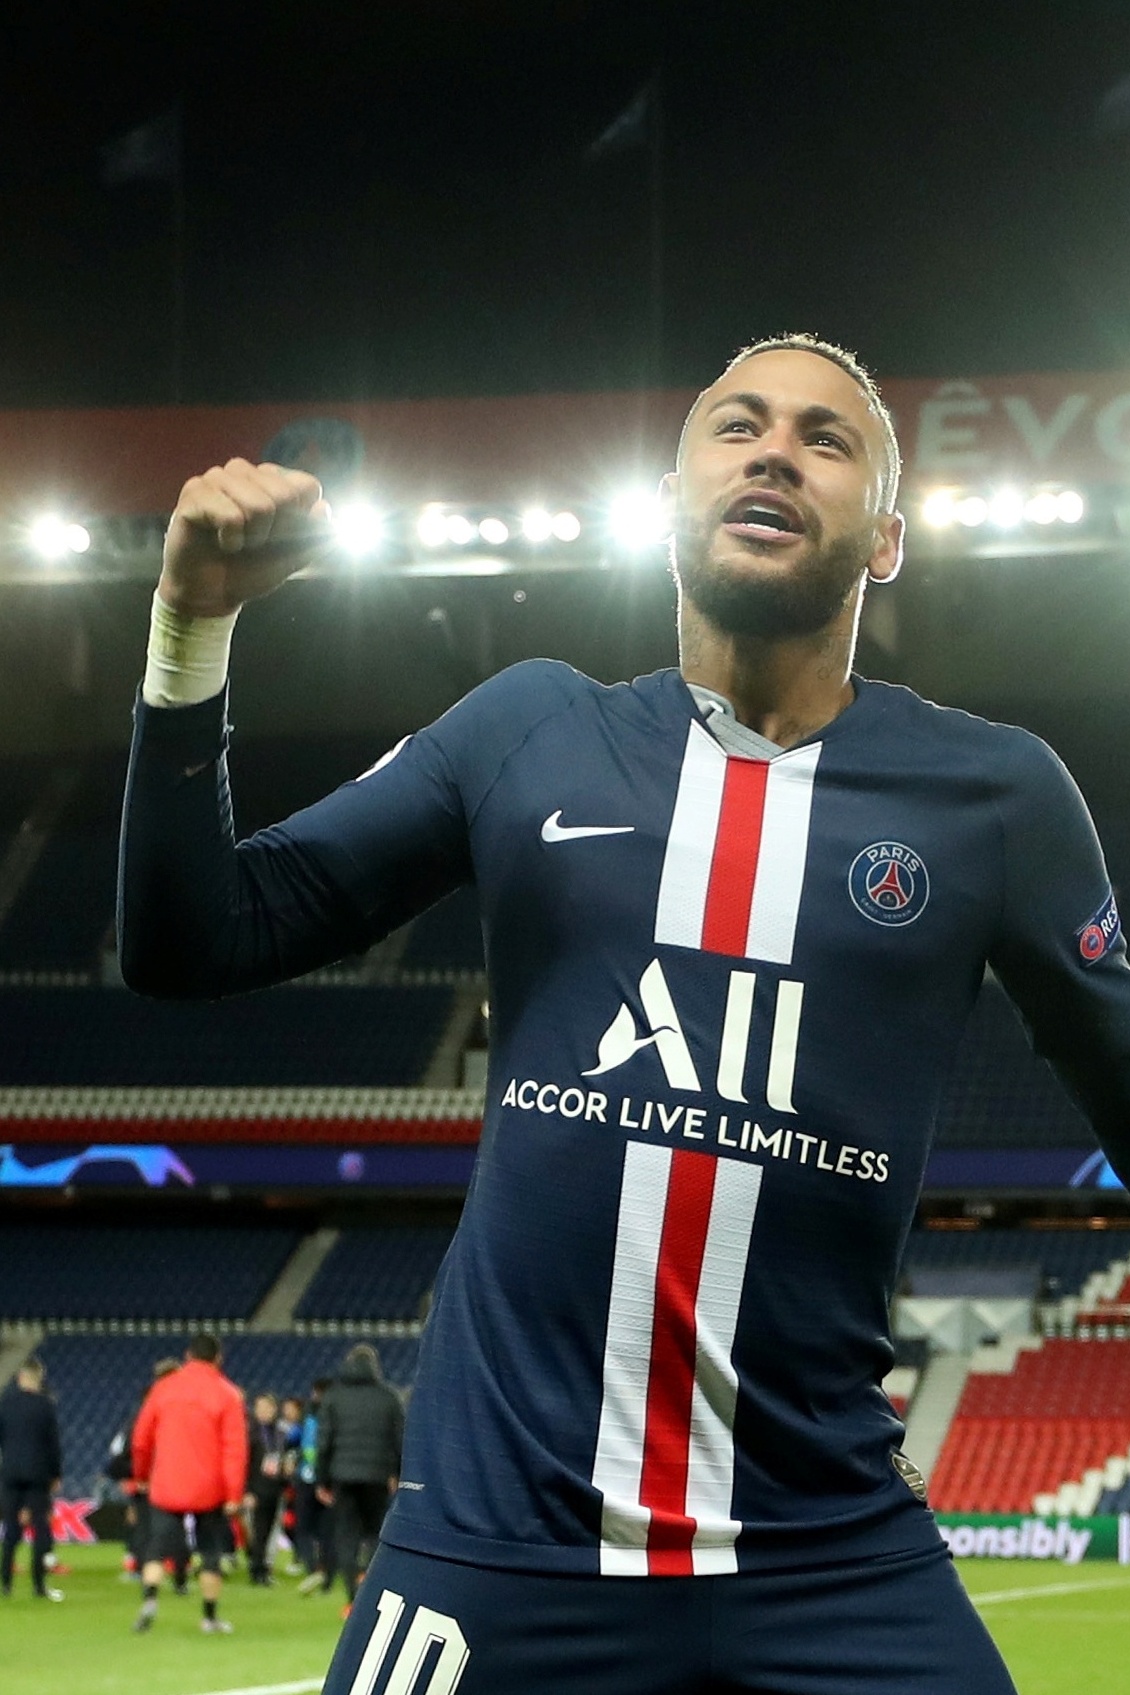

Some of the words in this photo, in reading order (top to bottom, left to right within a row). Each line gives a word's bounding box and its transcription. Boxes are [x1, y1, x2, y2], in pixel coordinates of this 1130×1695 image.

[866, 846, 920, 873] PARIS
[501, 1078, 608, 1124] ACCOR
[619, 1097, 706, 1140] LIVE
[717, 1115, 890, 1183] LIMITLESS
